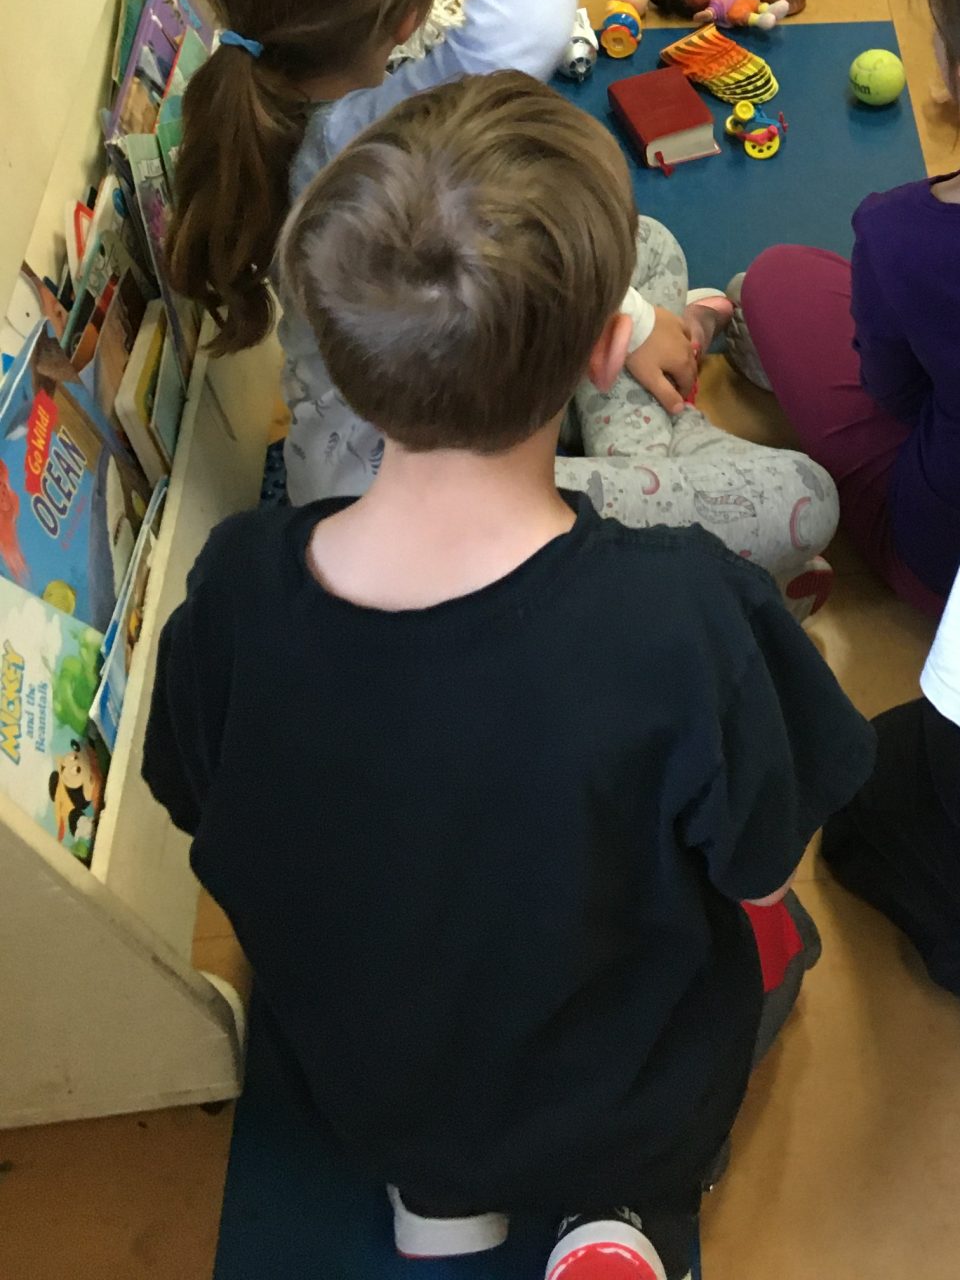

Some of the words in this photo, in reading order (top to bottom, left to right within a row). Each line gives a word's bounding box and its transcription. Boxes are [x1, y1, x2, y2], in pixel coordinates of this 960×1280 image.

[31, 404, 50, 451] Wild!
[28, 450, 43, 475] Go
[31, 425, 88, 539] OCEAN
[26, 683, 36, 707] the
[25, 708, 35, 740] and
[35, 679, 48, 754] Beanstalk
